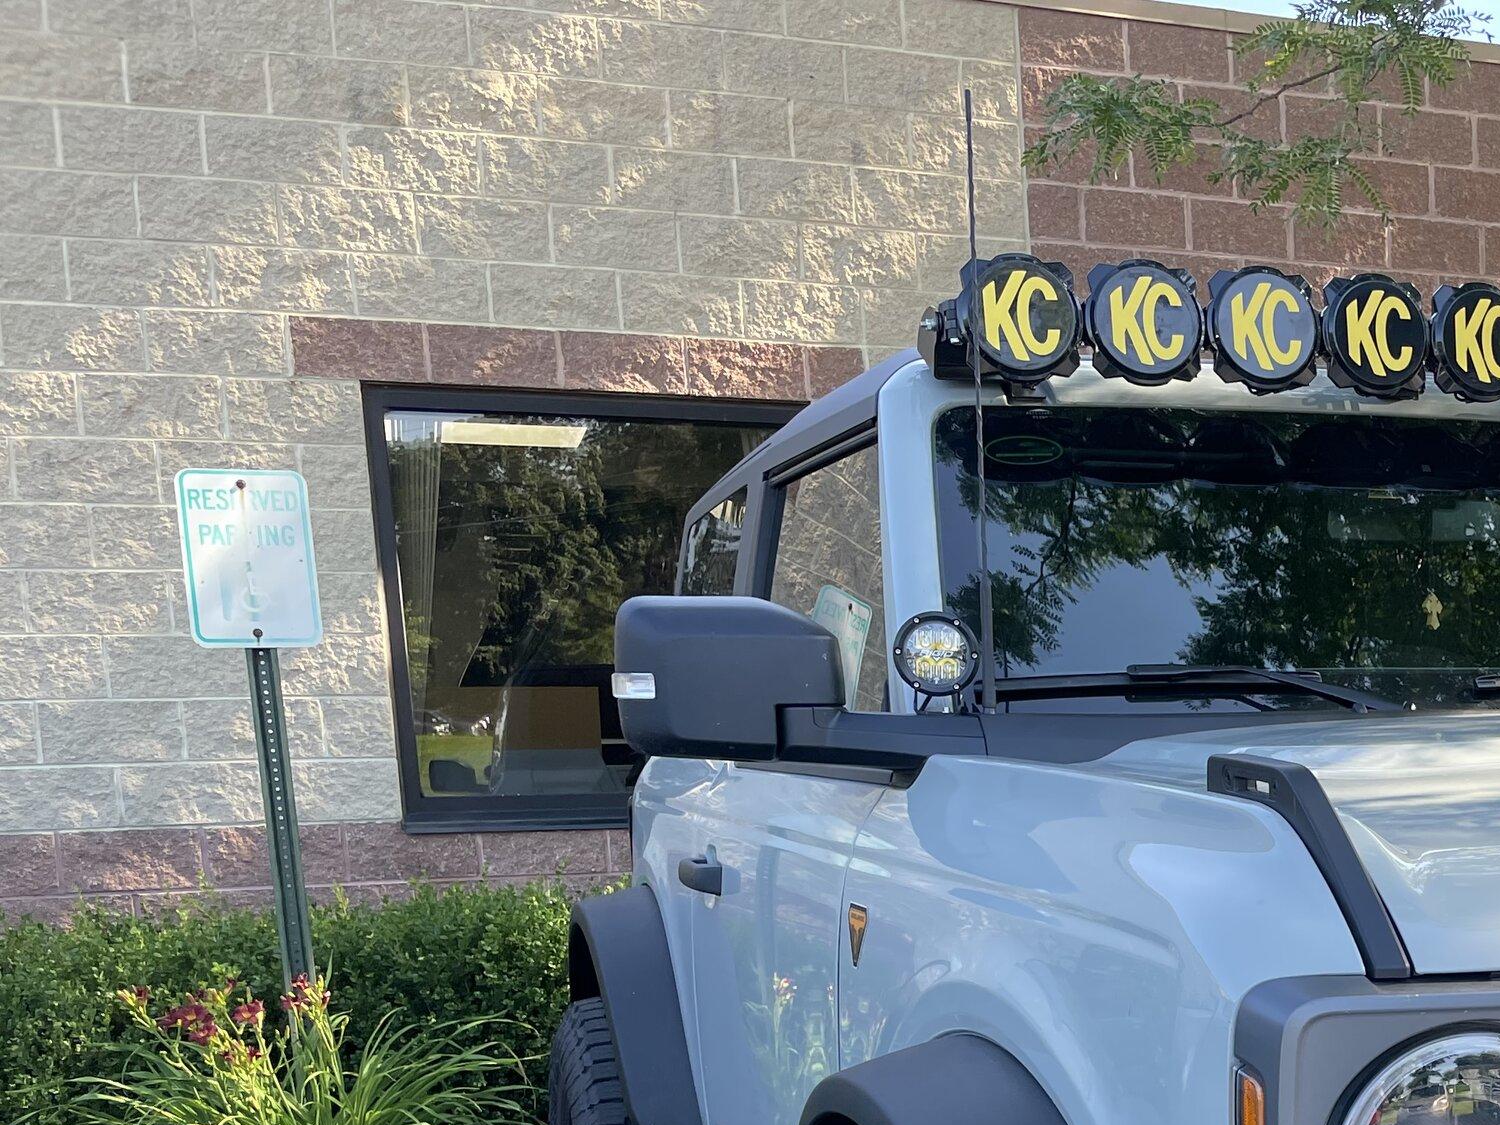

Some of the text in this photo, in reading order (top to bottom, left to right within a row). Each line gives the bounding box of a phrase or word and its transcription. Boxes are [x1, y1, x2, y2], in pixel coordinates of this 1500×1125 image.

[982, 270, 1061, 362] KC
[1109, 276, 1185, 366] KC
[1230, 282, 1302, 371] KC
[1346, 289, 1413, 377] KC
